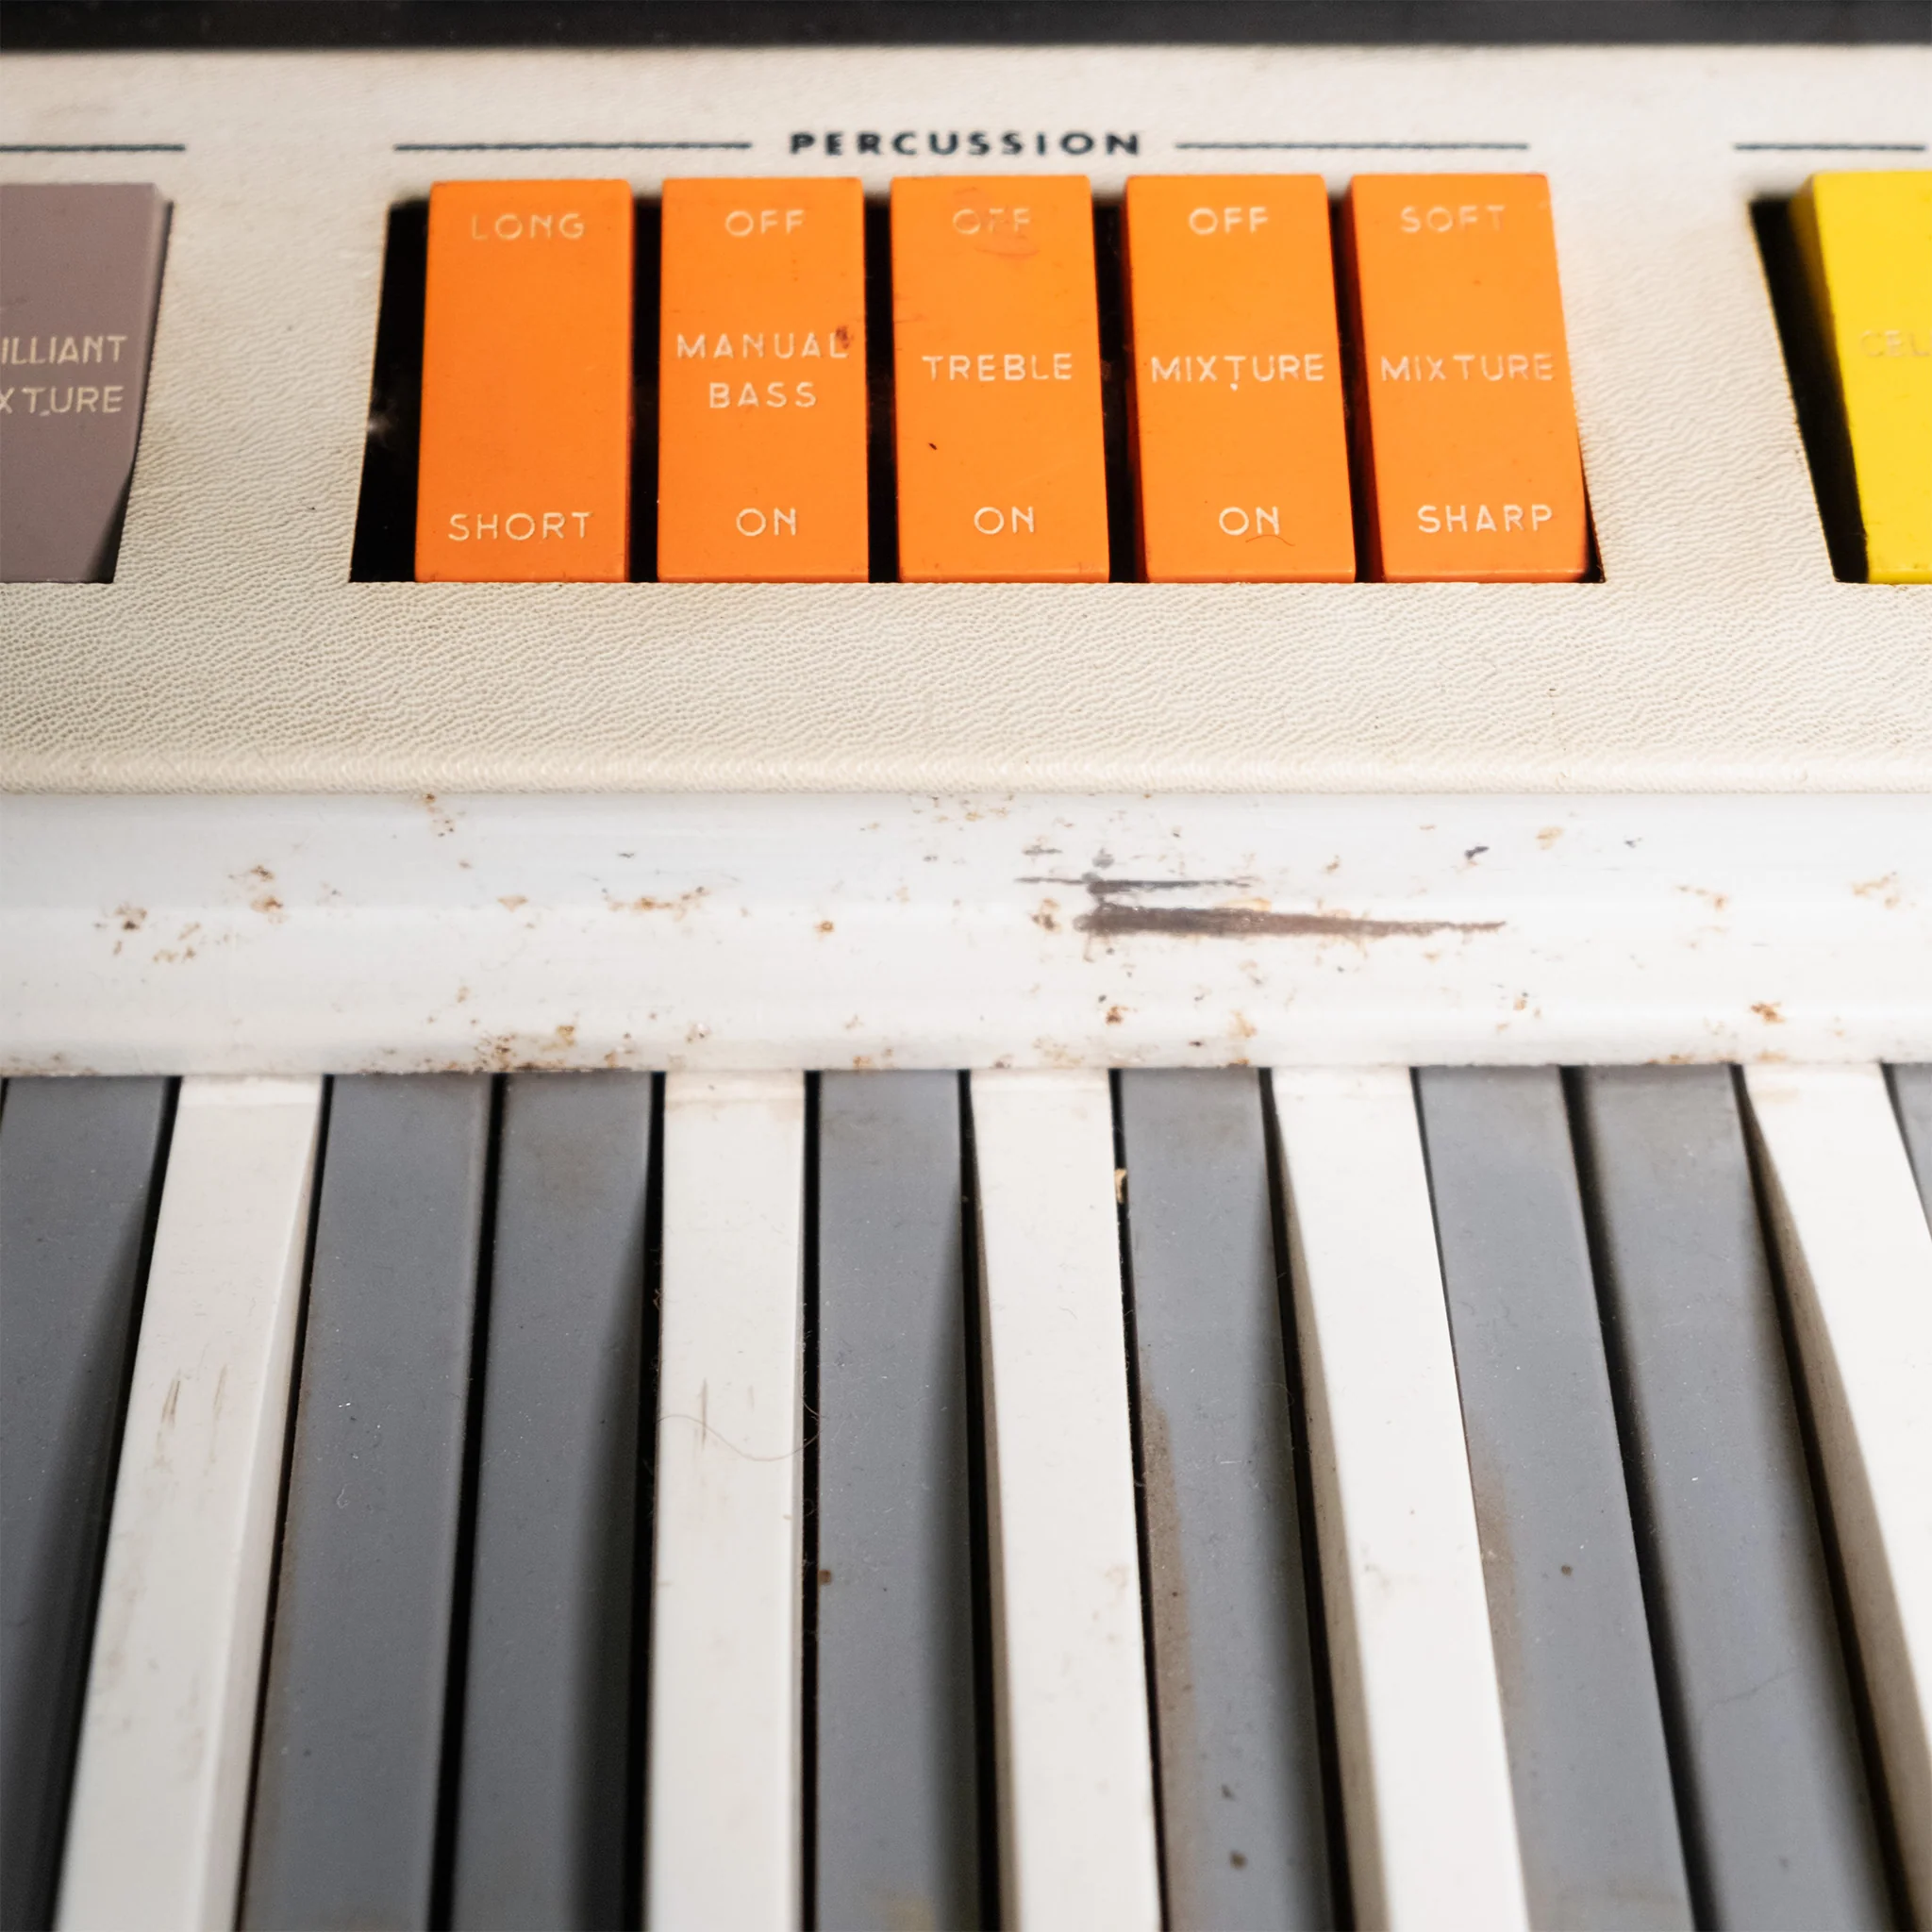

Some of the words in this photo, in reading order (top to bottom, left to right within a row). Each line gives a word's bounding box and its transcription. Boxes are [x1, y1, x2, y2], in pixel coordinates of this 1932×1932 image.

[790, 131, 1141, 156] PERCUSSION
[471, 213, 586, 241] LONG
[724, 208, 806, 237] OFF
[951, 207, 1032, 235] OFF
[1188, 206, 1269, 235] OFF
[1399, 205, 1507, 233] SOFT
[0, 335, 127, 364] ILLIANT
[676, 332, 848, 359] MANUAL
[1858, 329, 1932, 358] CEL
[921, 353, 1074, 381] TREBLE
[1149, 354, 1325, 382] MIXTURE
[1380, 354, 1555, 382] MIXTURE
[708, 381, 818, 409] BASS
[448, 511, 591, 541] SHORT
[735, 508, 798, 536] ON
[973, 506, 1036, 534] ON
[1219, 506, 1280, 536] ON
[1417, 504, 1553, 533] SHARP
